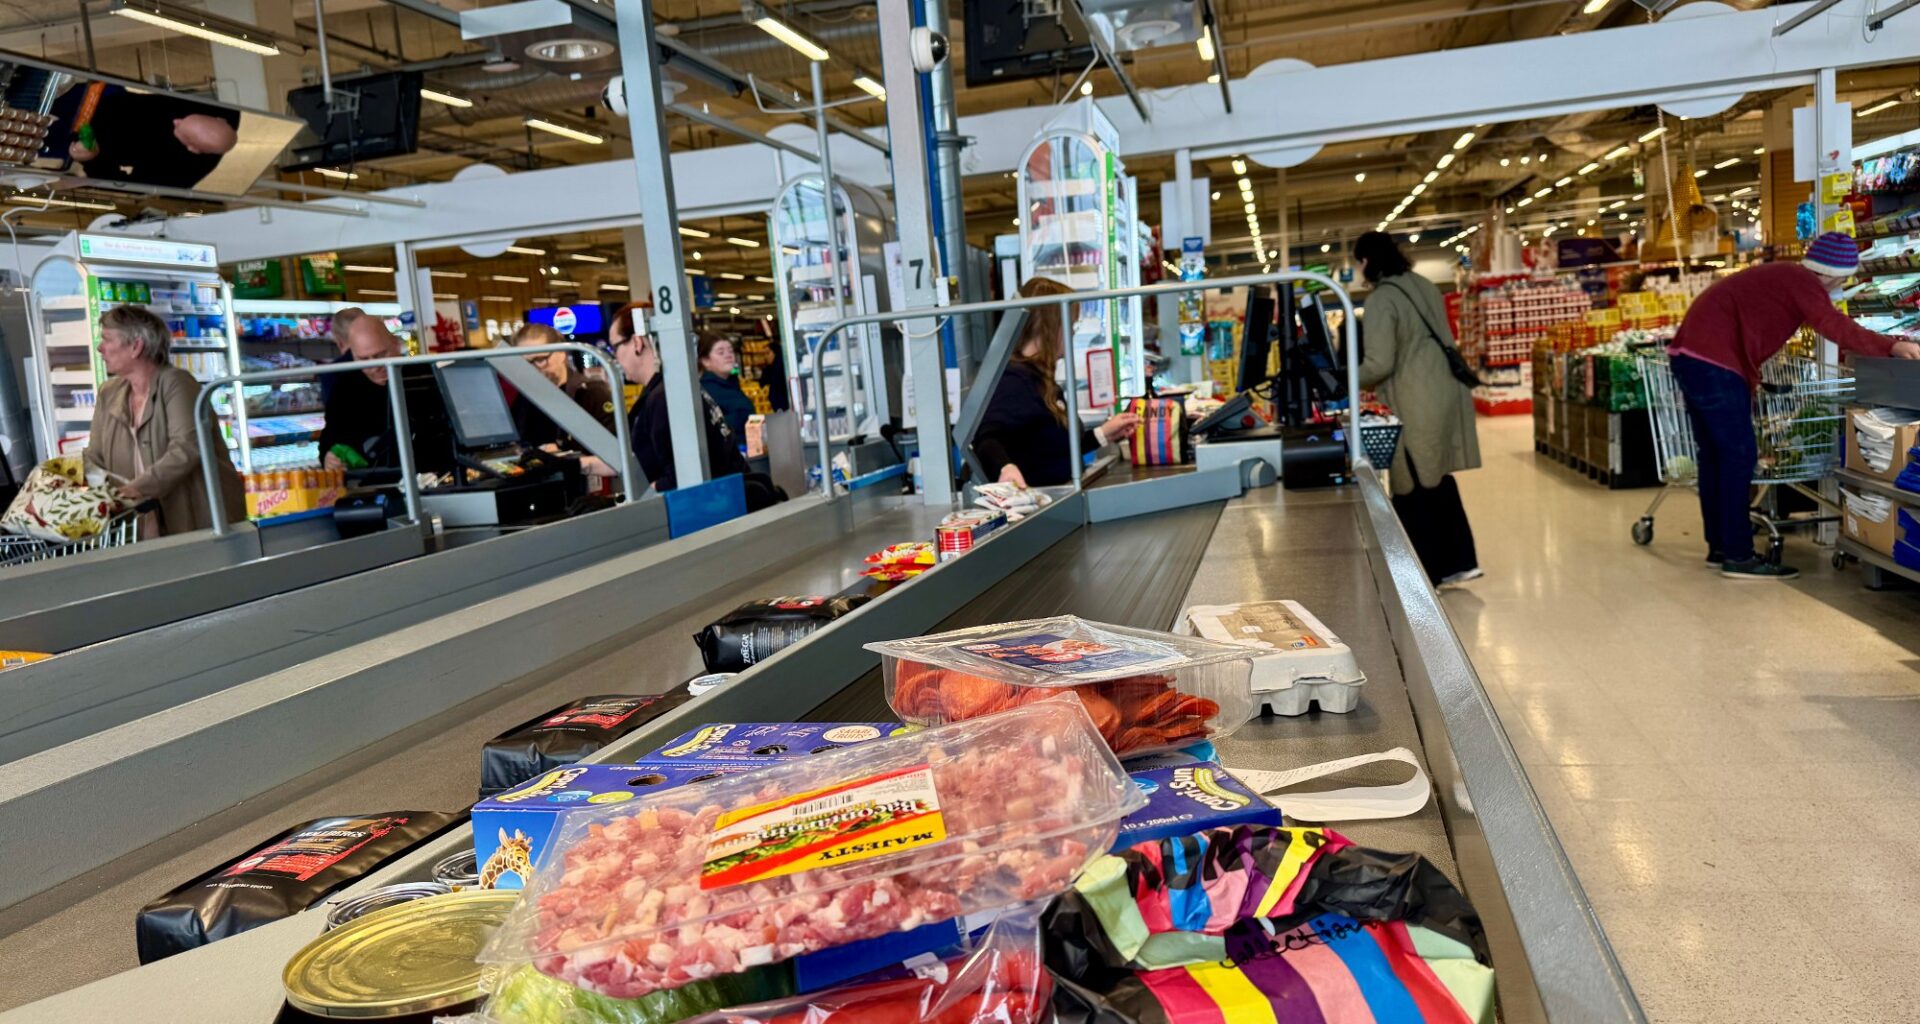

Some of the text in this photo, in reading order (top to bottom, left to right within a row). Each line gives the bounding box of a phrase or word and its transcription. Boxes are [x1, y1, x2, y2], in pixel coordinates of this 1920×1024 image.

[909, 259, 924, 289] 7
[658, 285, 673, 314] 8
[256, 489, 288, 512] ZINGO
[1169, 767, 1241, 811] Capri-Sun
[1122, 822, 1137, 831] 10
[819, 831, 934, 861] MAJESTY
